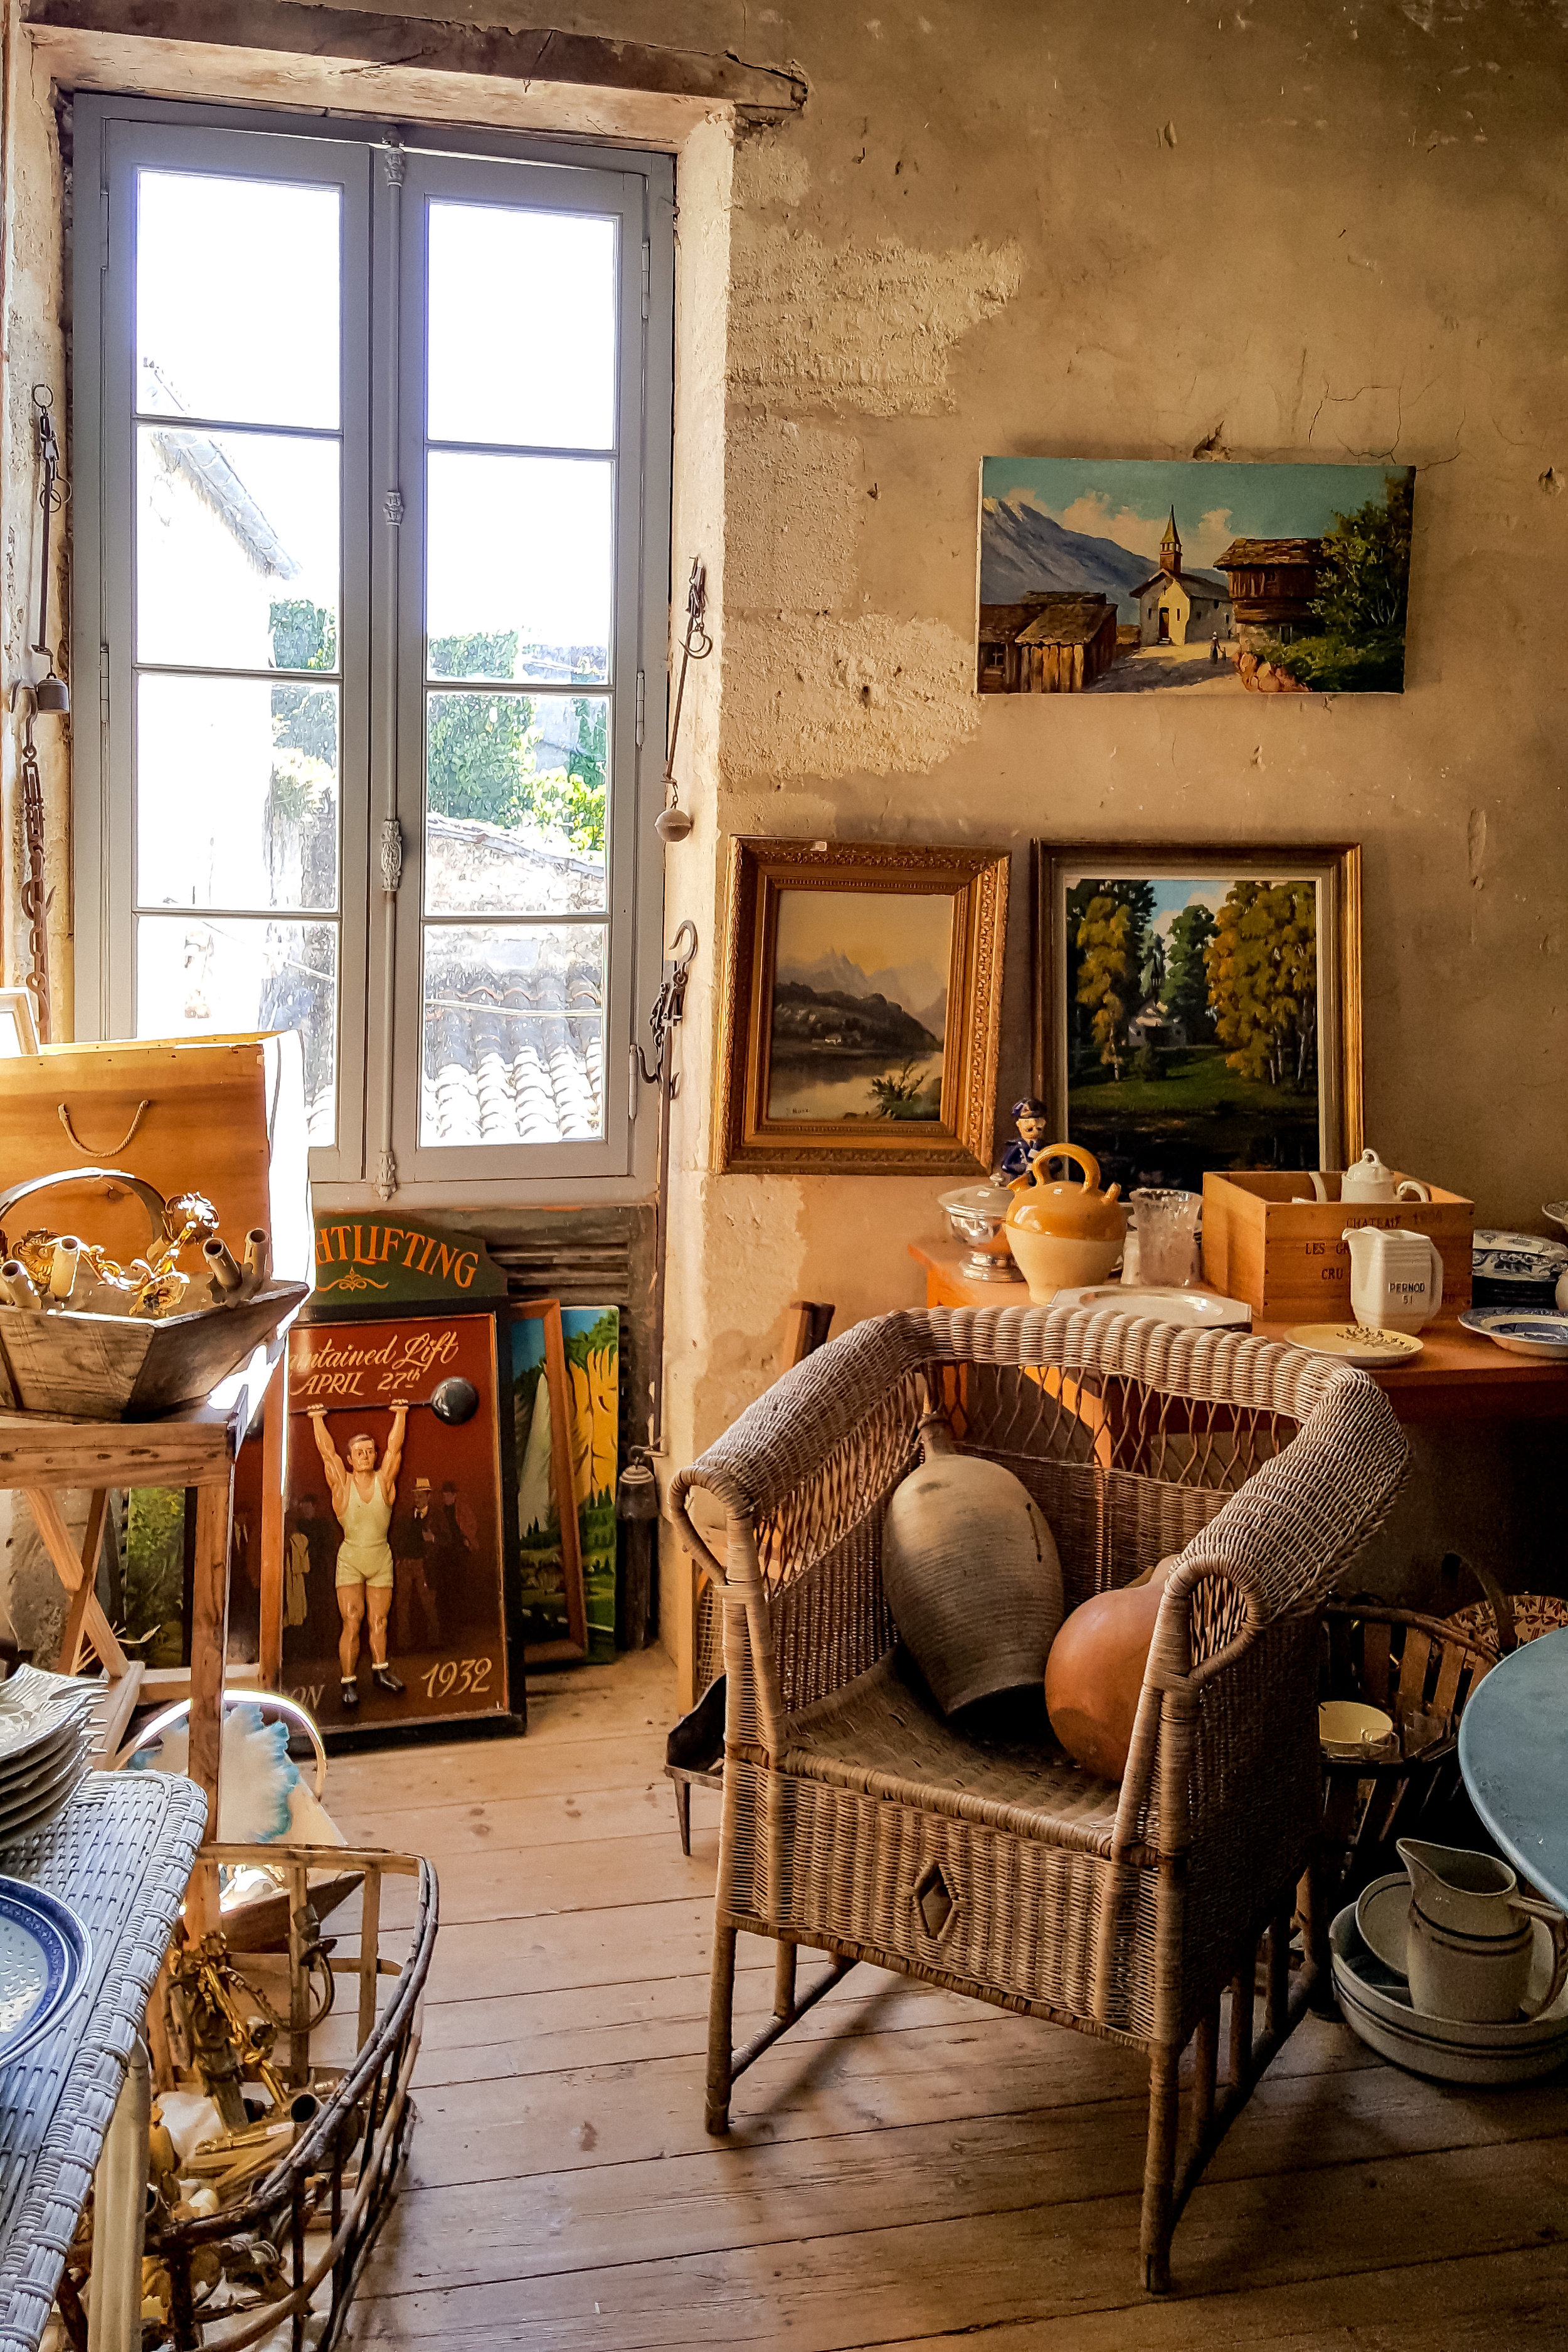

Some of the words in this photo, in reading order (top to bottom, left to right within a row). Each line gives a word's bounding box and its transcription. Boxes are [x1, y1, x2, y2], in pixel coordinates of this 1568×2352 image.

[1305, 1242, 1325, 1254] LES
[1322, 1268, 1343, 1279] CRU
[1389, 1281, 1425, 1293] PERNOD
[1402, 1295, 1412, 1305] 51
[392, 1331, 458, 1373] Lift
[290, 1372, 364, 1396] APRIL
[377, 1369, 421, 1392] 27th
[421, 1658, 492, 1697] 1932
